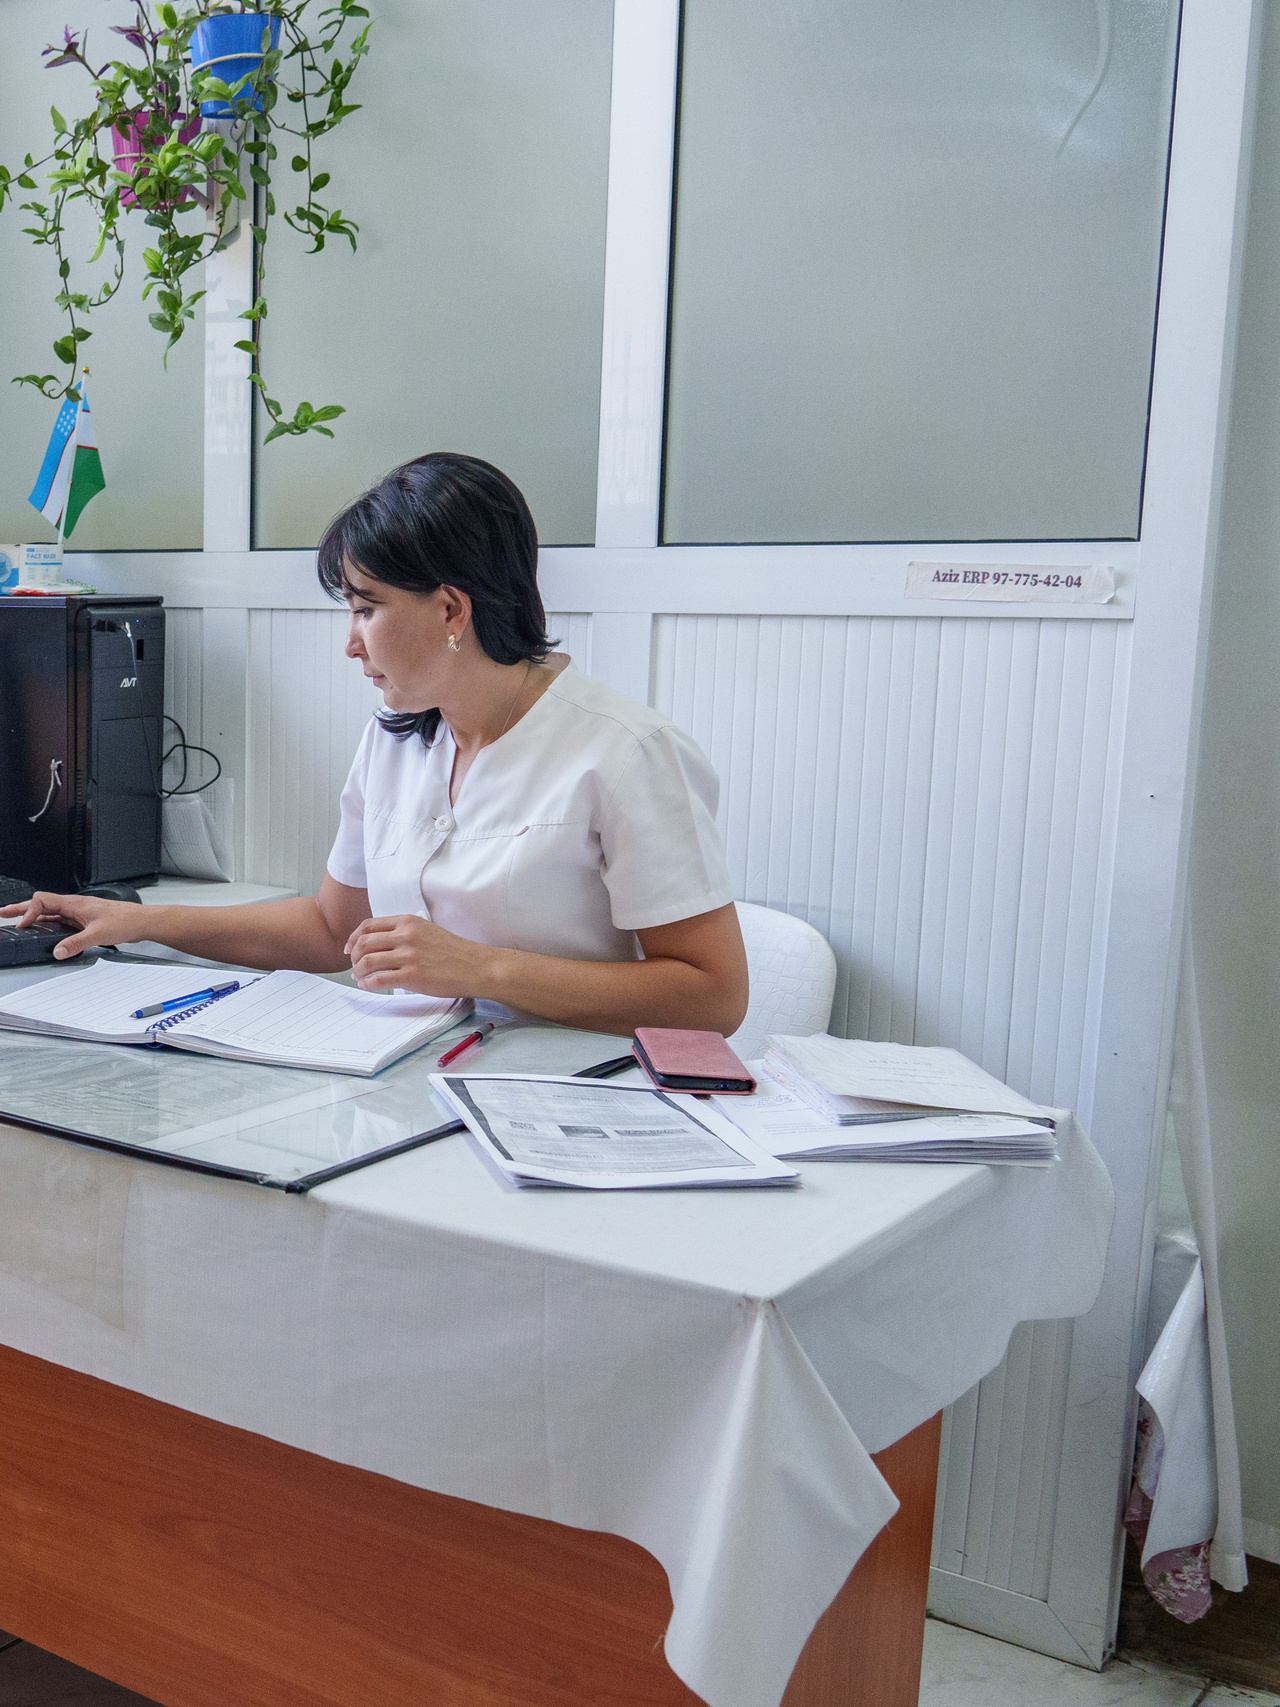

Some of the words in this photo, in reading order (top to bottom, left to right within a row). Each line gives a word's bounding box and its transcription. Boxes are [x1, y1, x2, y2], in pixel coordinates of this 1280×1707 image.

[932, 569, 960, 584] Aziz
[962, 570, 990, 584] ERP
[992, 572, 1083, 588] 97-775-42-04
